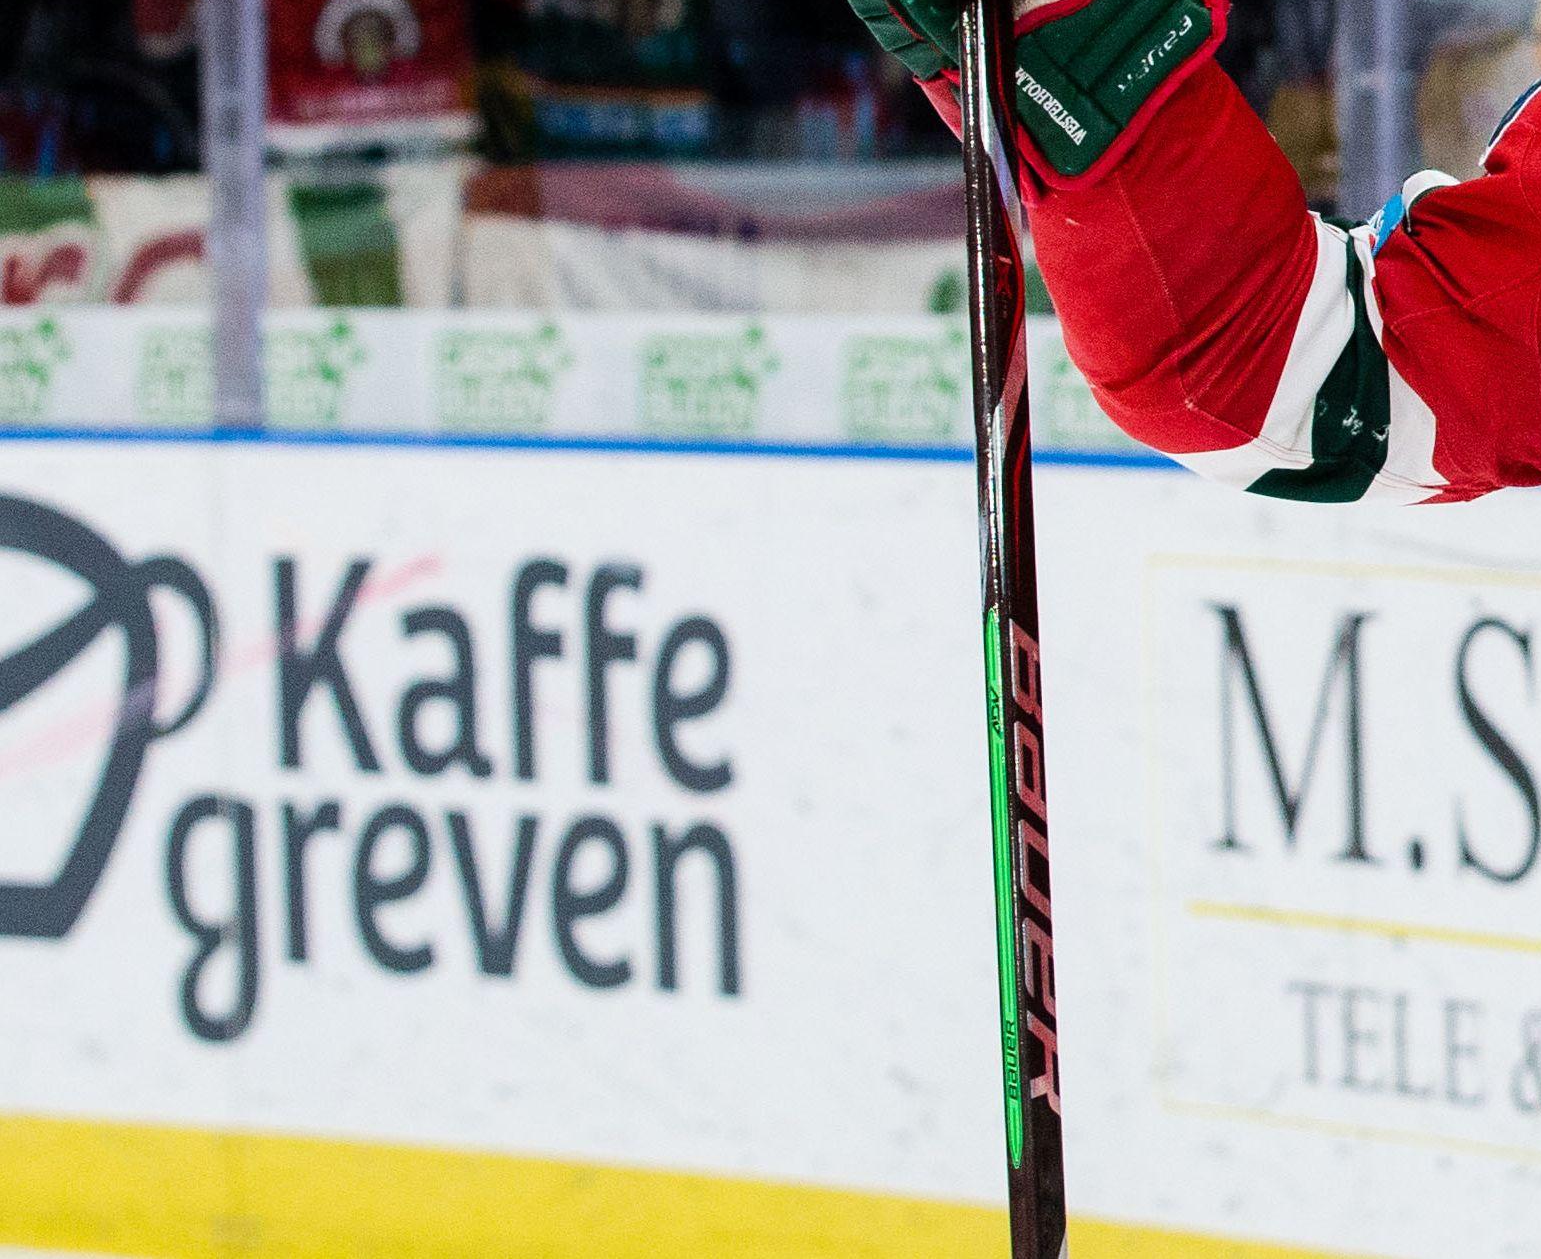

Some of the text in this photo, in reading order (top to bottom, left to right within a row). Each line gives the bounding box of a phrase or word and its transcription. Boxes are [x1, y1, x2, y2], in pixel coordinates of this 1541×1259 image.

[1015, 64, 1088, 146] WESTERHOLM
[272, 556, 735, 794] Kaffe
[164, 792, 743, 1044] greven
[1009, 618, 1062, 1118] BAUER
[1287, 978, 1488, 1110] TELE
